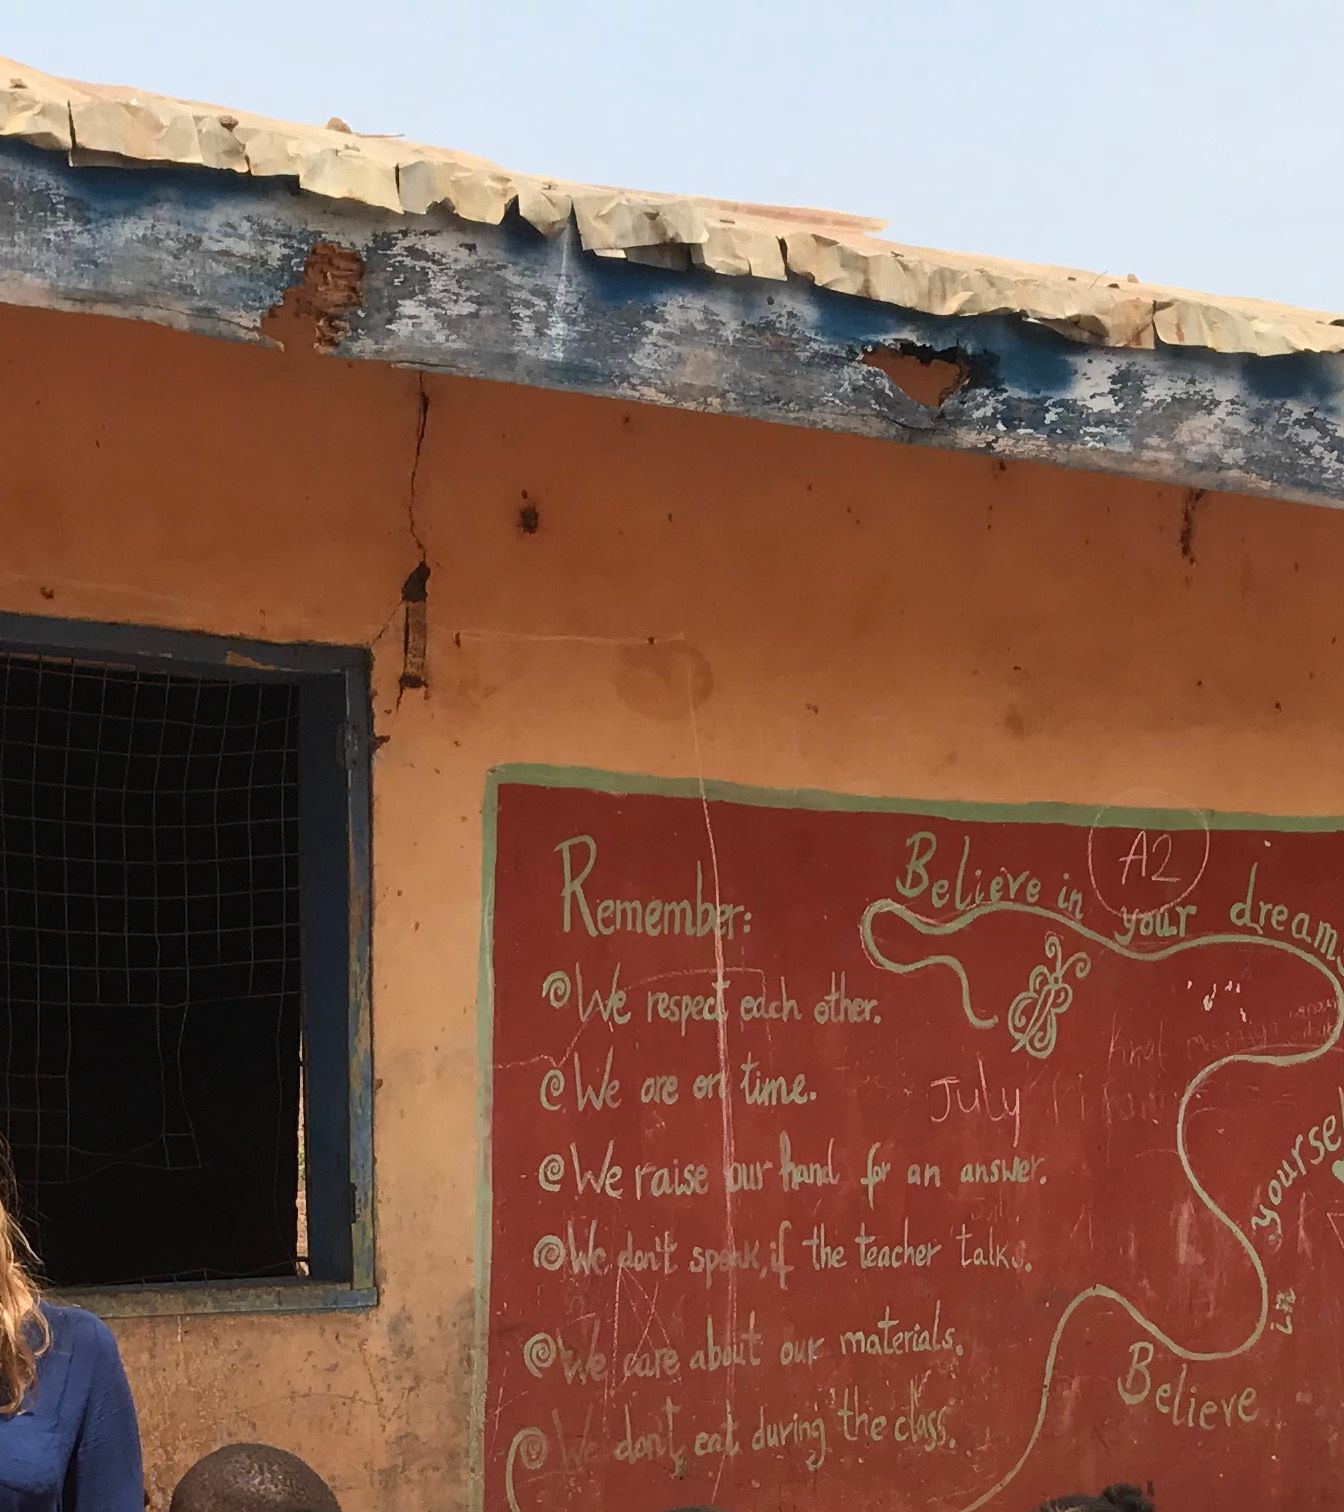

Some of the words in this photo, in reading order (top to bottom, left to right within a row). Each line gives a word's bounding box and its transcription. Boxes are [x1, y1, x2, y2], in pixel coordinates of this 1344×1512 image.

[554, 834, 752, 940] Remember:
[895, 831, 1041, 912] Believe
[1058, 872, 1084, 922] in
[1115, 902, 1197, 944] your
[1119, 830, 1184, 885] A2
[575, 962, 631, 1026] We
[647, 979, 729, 1036] respect
[740, 976, 801, 1023] each
[814, 971, 882, 1025] other.
[574, 1046, 622, 1112] We
[640, 1074, 682, 1105] are
[692, 1076, 724, 1104] on
[740, 1051, 817, 1106] time.
[930, 1053, 1021, 1148] July
[569, 1140, 624, 1200] We
[634, 1158, 709, 1201] raise
[726, 1160, 774, 1193] our
[778, 1130, 840, 1193] hand
[860, 1141, 892, 1210] for
[907, 1162, 941, 1186] an
[960, 1155, 1047, 1186] answer.
[567, 1219, 609, 1275] We
[802, 1222, 847, 1272] the
[856, 1217, 943, 1270] teacher
[555, 1318, 608, 1386] We
[622, 1346, 680, 1379] care
[688, 1310, 763, 1372] about
[779, 1336, 825, 1370] our
[840, 1299, 965, 1356] materials.
[1117, 1340, 1260, 1431] Believe
[693, 1398, 743, 1457] eat
[750, 1405, 828, 1472] during
[836, 1385, 888, 1442] the
